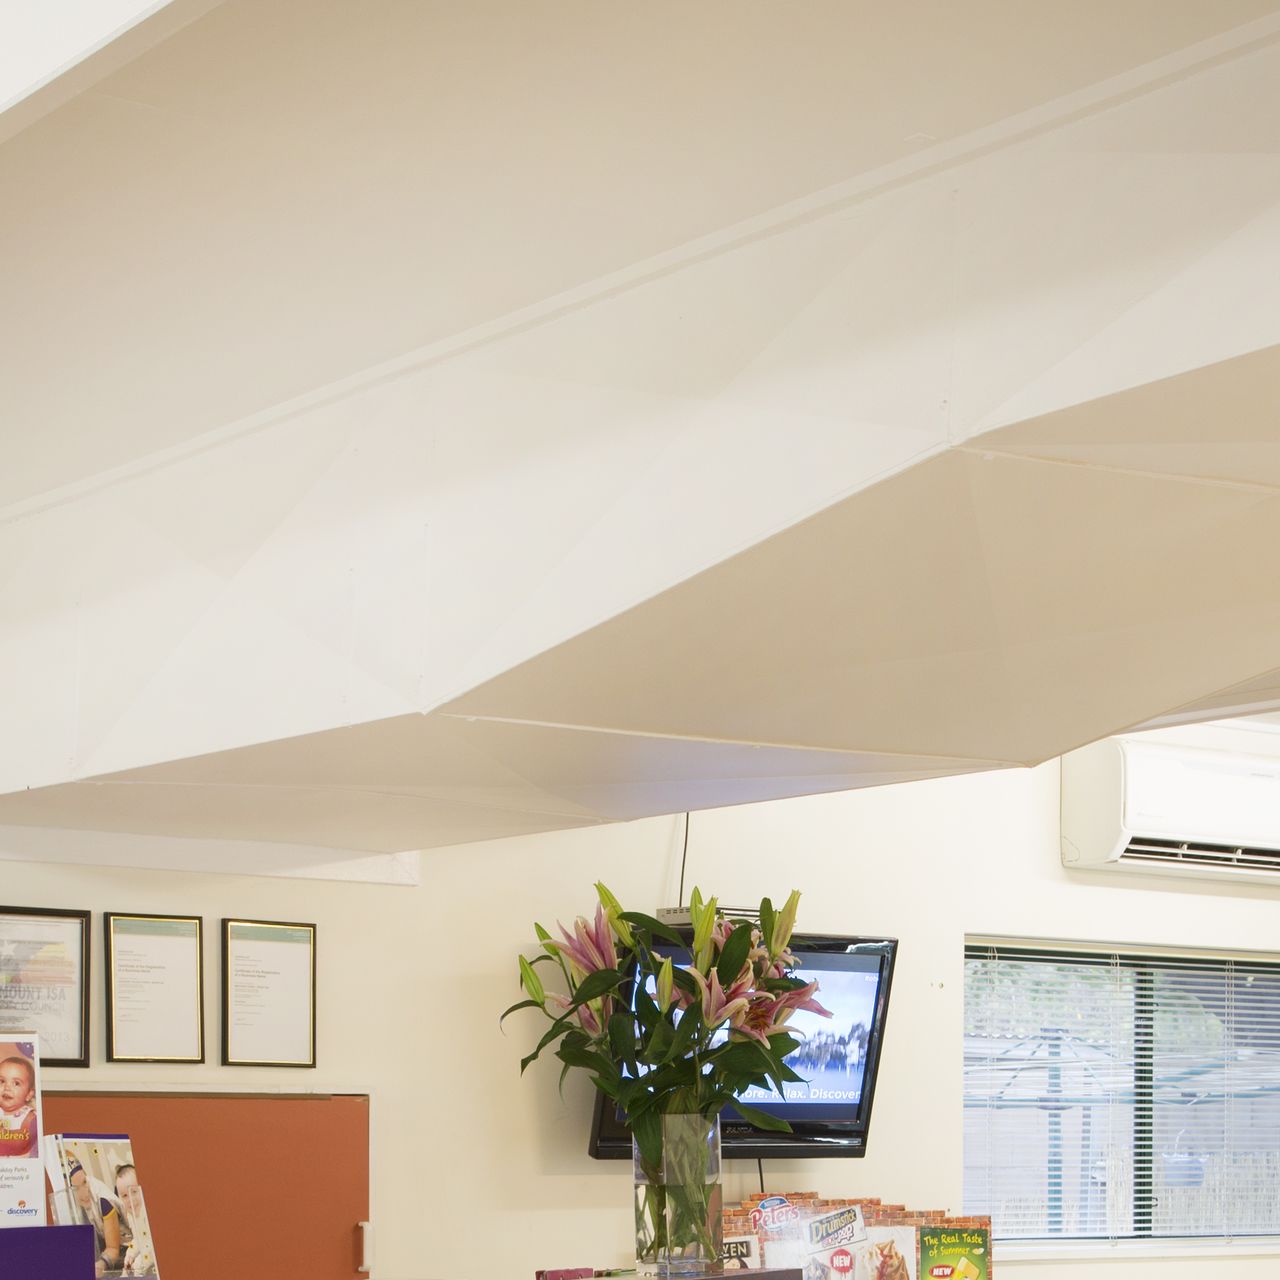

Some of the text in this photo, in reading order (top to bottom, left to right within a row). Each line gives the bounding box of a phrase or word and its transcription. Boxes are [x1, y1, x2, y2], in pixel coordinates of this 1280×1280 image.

[47, 987, 66, 1001] ISA
[7, 1207, 39, 1216] discovery
[749, 1204, 799, 1232] Peters
[810, 1208, 857, 1243] Drumstick
[924, 1232, 983, 1246] The Real Taste
[928, 1244, 969, 1257] of Summer
[833, 1255, 851, 1267] NEW
[932, 1266, 952, 1276] NEW
